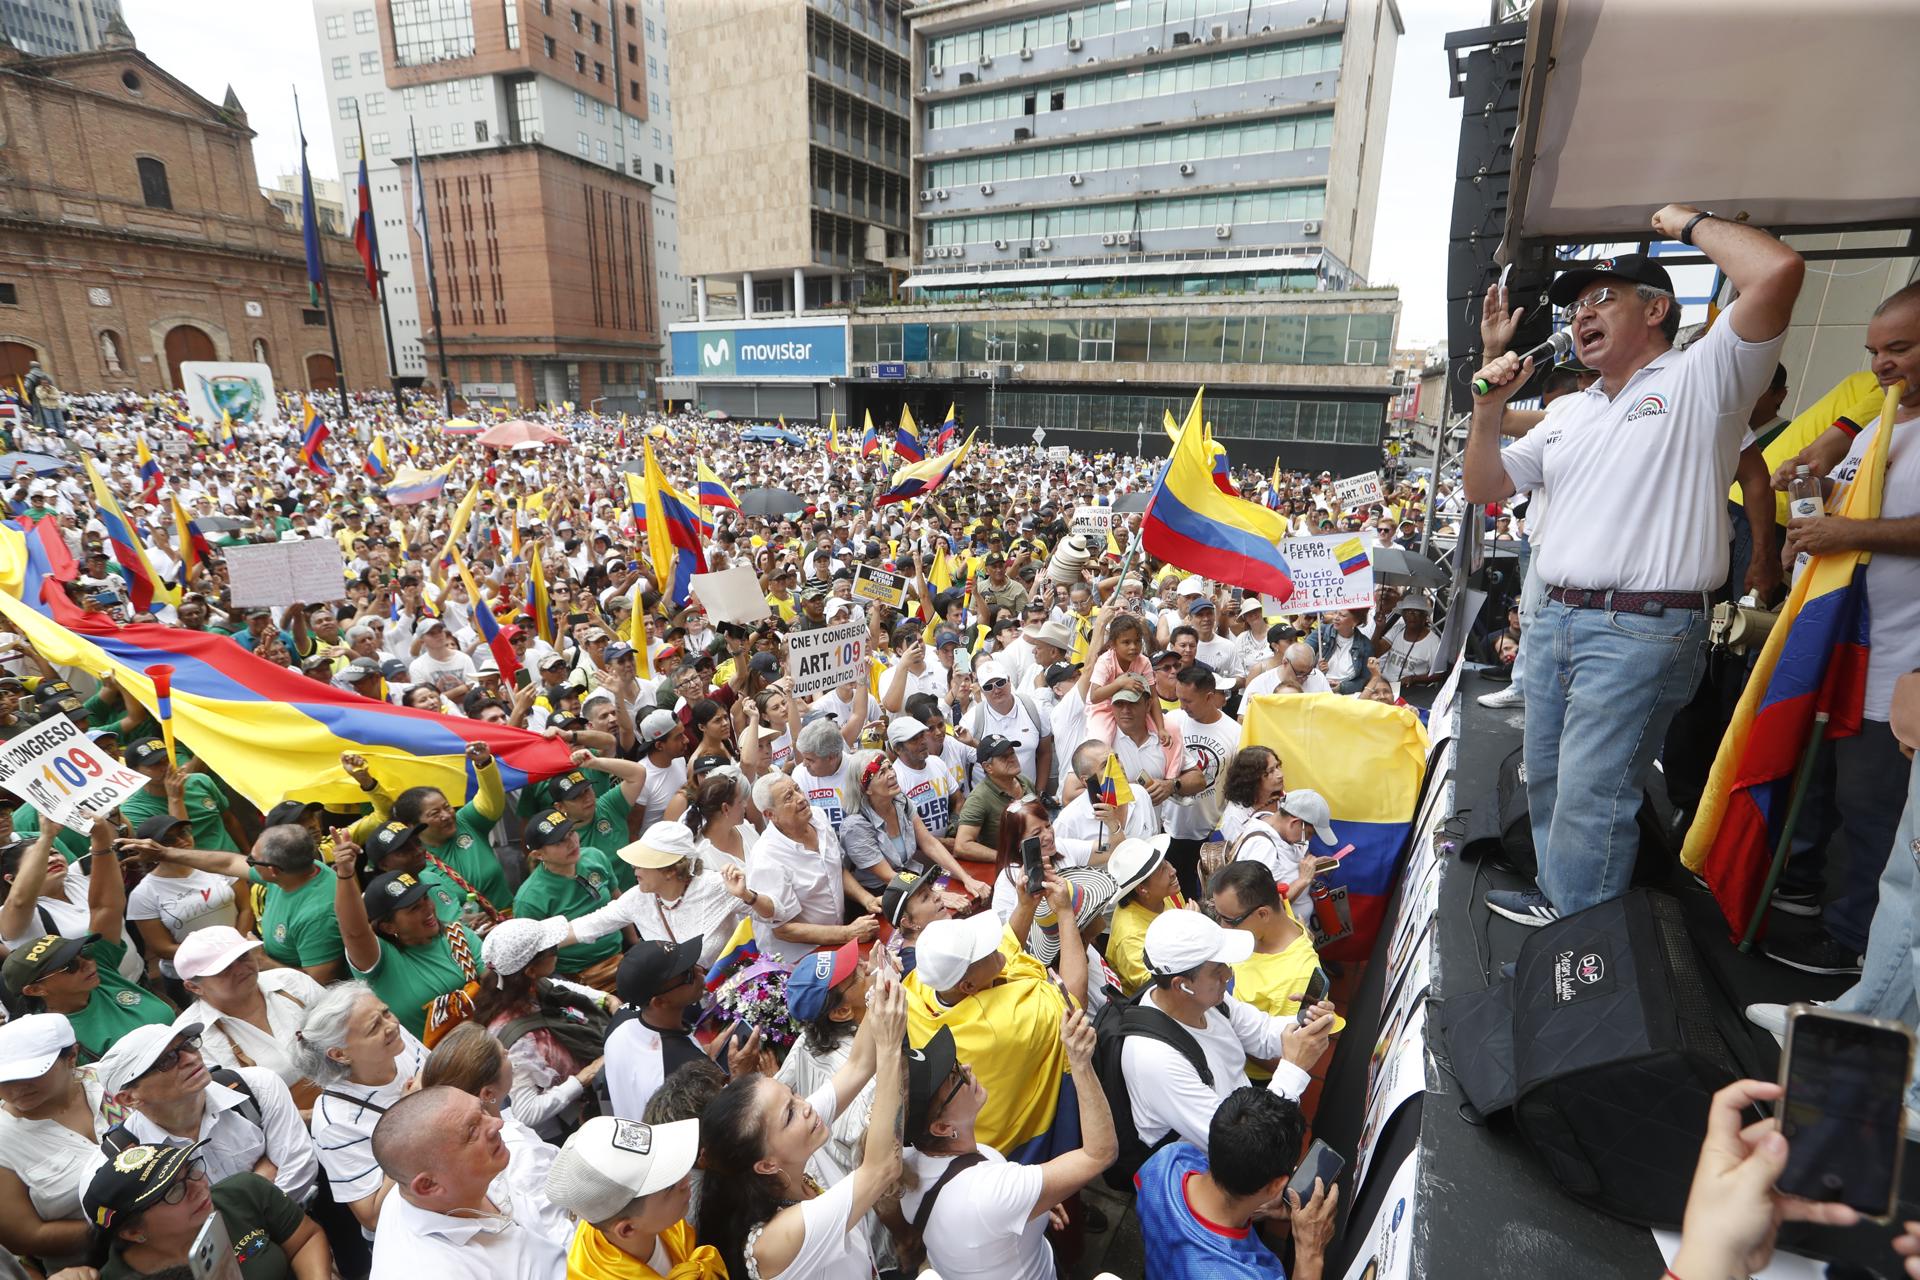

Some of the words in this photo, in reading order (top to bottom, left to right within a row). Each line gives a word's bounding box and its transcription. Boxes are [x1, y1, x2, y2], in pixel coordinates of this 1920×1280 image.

[741, 343, 812, 361] movistar
[1627, 408, 1668, 422] NACIONAL
[1350, 473, 1377, 485] CONGRESO
[1341, 489, 1360, 501] ART.
[1359, 482, 1377, 495] 109
[1075, 516, 1092, 527] ART.
[1092, 515, 1108, 528] 109
[1313, 598, 1323, 607] de
[791, 635, 811, 649] CNE
[813, 633, 819, 645] Y
[822, 623, 866, 644] CONGRESO
[799, 652, 832, 677] ART.
[834, 640, 861, 667] 109
[793, 679, 821, 694] JUICIO
[822, 669, 854, 687] POLÍTICO
[854, 663, 865, 677] YA
[9, 721, 77, 769] CONGRESO
[1184, 734, 1226, 756] NOMIZED
[41, 747, 103, 796] 109
[105, 769, 145, 789] YA
[26, 778, 61, 814] ART.
[917, 798, 948, 819] UER
[1561, 978, 1577, 1001] Audio
